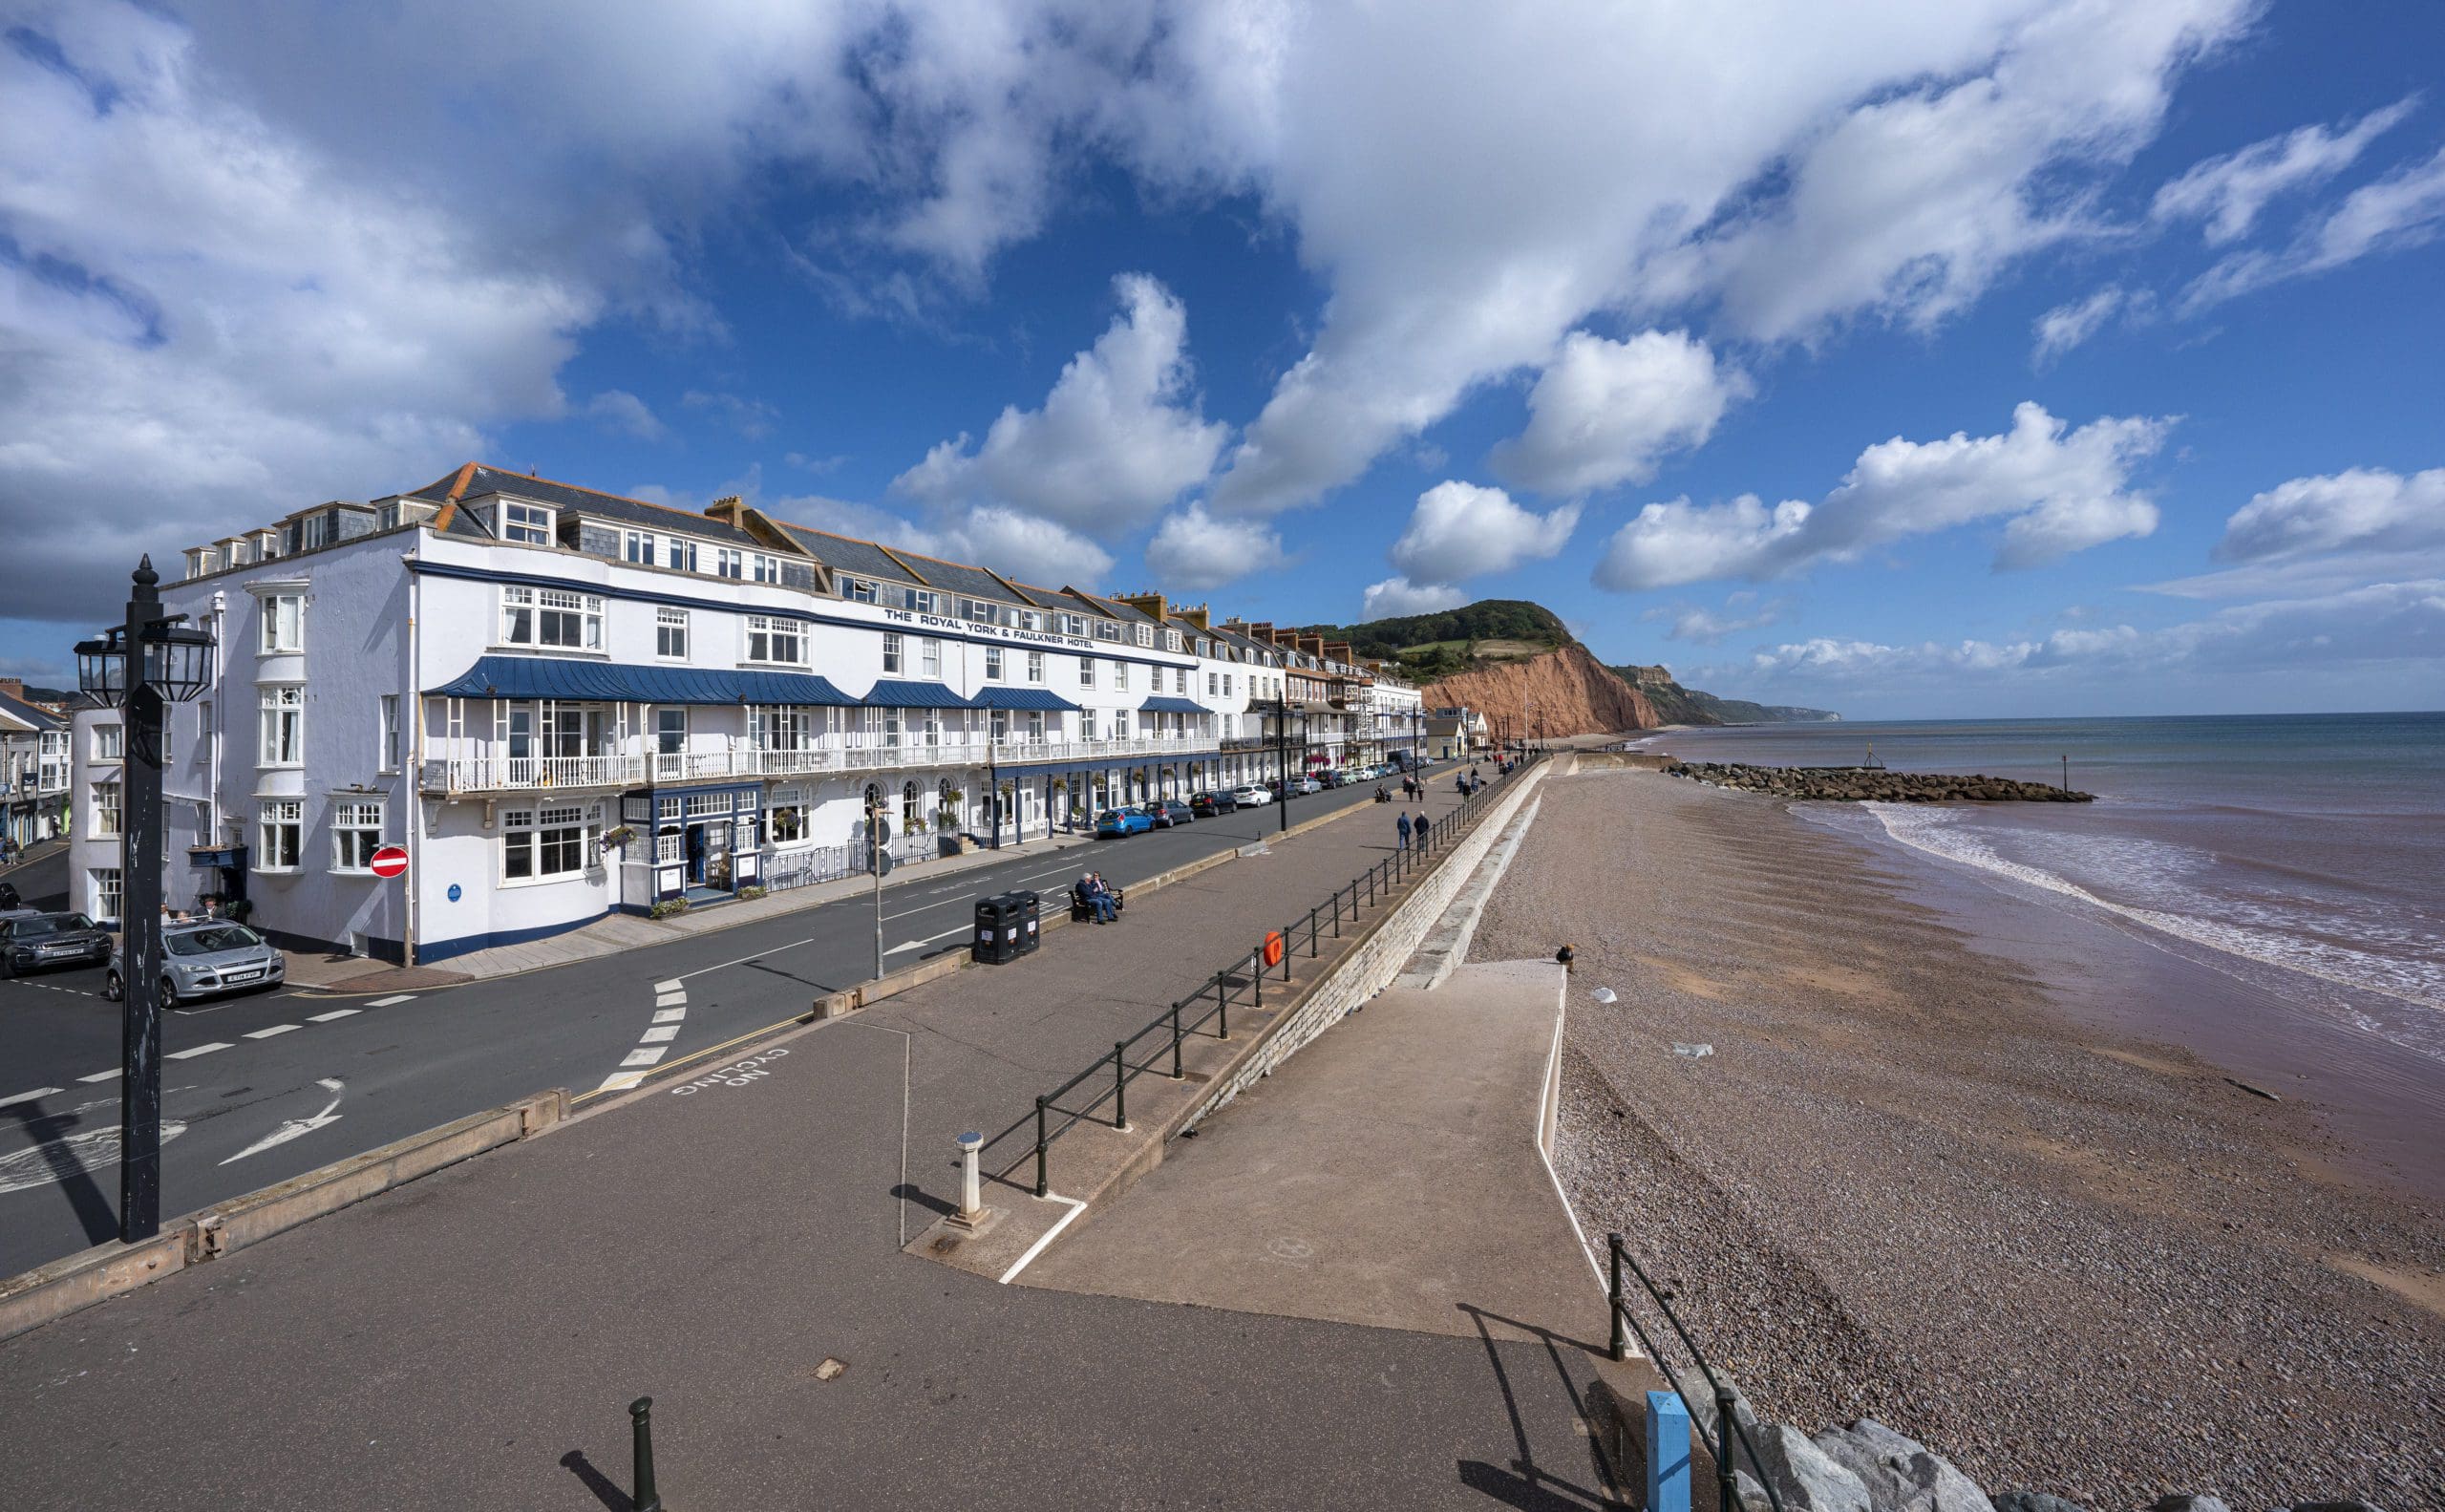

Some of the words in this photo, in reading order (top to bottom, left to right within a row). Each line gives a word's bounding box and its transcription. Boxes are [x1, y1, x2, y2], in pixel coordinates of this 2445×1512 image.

[884, 608, 912, 622] THE
[920, 615, 962, 629] ROYAL
[967, 623, 997, 636] YORK
[1002, 628, 1010, 637] &
[1013, 630, 1064, 645] FAULKNER
[1067, 638, 1094, 649] HOTEL
[671, 1049, 789, 1095] CYCLING
[726, 1070, 770, 1086] NO
